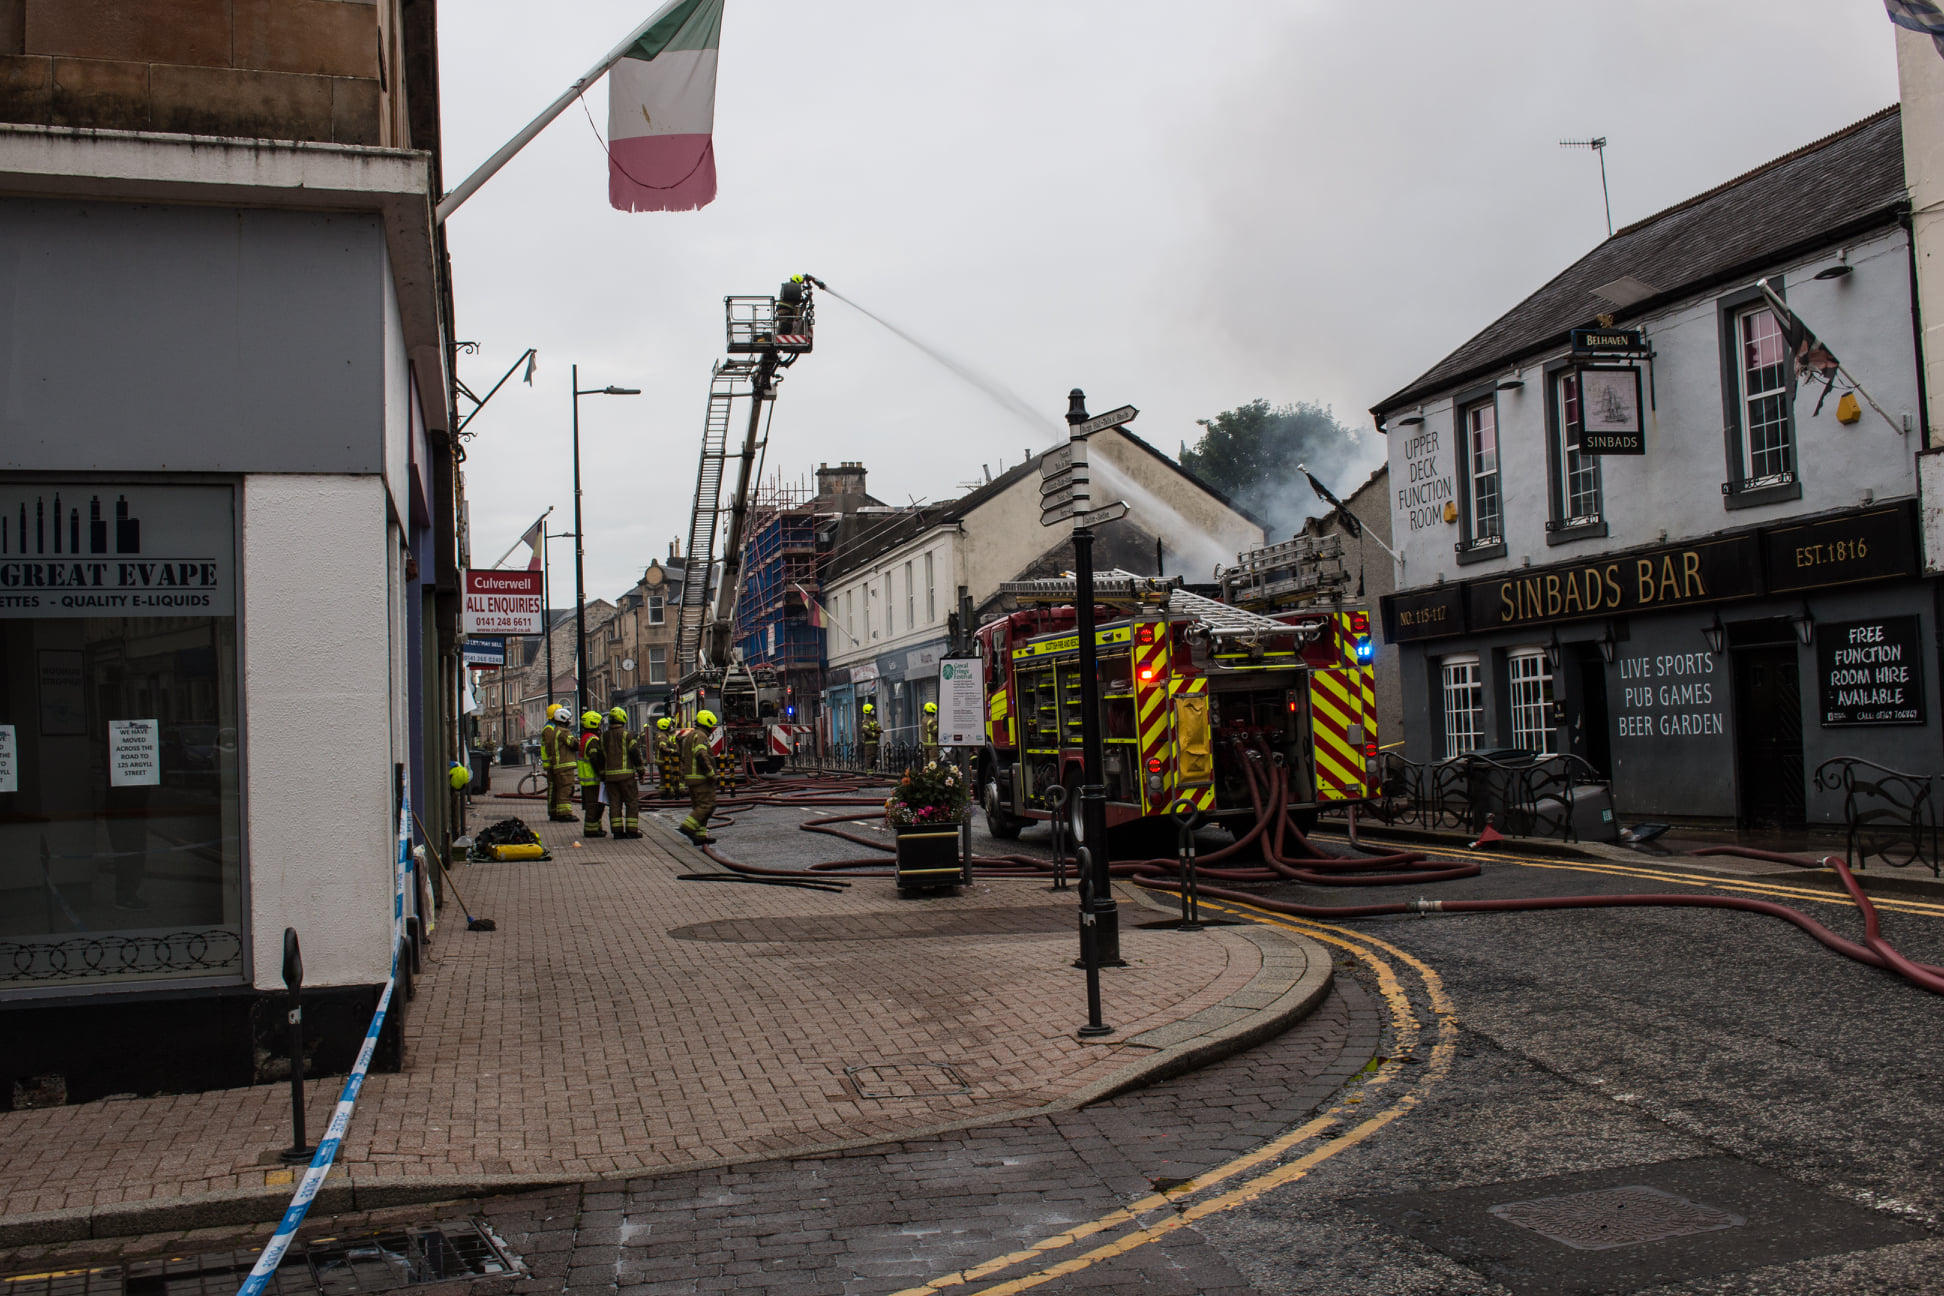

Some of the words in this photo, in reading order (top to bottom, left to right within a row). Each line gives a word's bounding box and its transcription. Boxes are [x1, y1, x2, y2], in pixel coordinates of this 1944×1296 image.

[1586, 334, 1628, 346] BELHAVEN
[1405, 431, 1440, 460] UPPER
[1587, 436, 1638, 448] SINBADS
[1409, 456, 1438, 483] DECK
[1398, 475, 1452, 510] FUNCTION
[1409, 503, 1443, 531] ROOM
[1, 563, 107, 587] GREAT
[117, 562, 217, 587] EVAPE
[475, 577, 531, 590] Culverwell
[1500, 564, 1622, 622] SINBADS
[1637, 551, 1705, 604] BAR
[61, 595, 127, 609] QUALITY
[132, 594, 210, 607] E-LIQUIDS
[467, 596, 485, 613] ALL
[488, 596, 540, 615] ENQUIRIES
[476, 617, 495, 626] 0141
[497, 617, 511, 626] 248
[513, 617, 531, 626] 6611
[1848, 625, 1884, 644] FREE
[1620, 657, 1651, 679] LIVE
[1656, 652, 1713, 677] SPORTS
[1834, 643, 1901, 666] FUNCTION
[1831, 668, 1870, 686] ROOM
[1875, 666, 1909, 684] HIRE
[1625, 686, 1654, 708] PUB
[1659, 682, 1712, 706] GAMES
[1838, 688, 1904, 706] AVAILABLE
[1618, 715, 1654, 737] BEER
[1660, 713, 1723, 736] GARDEN
